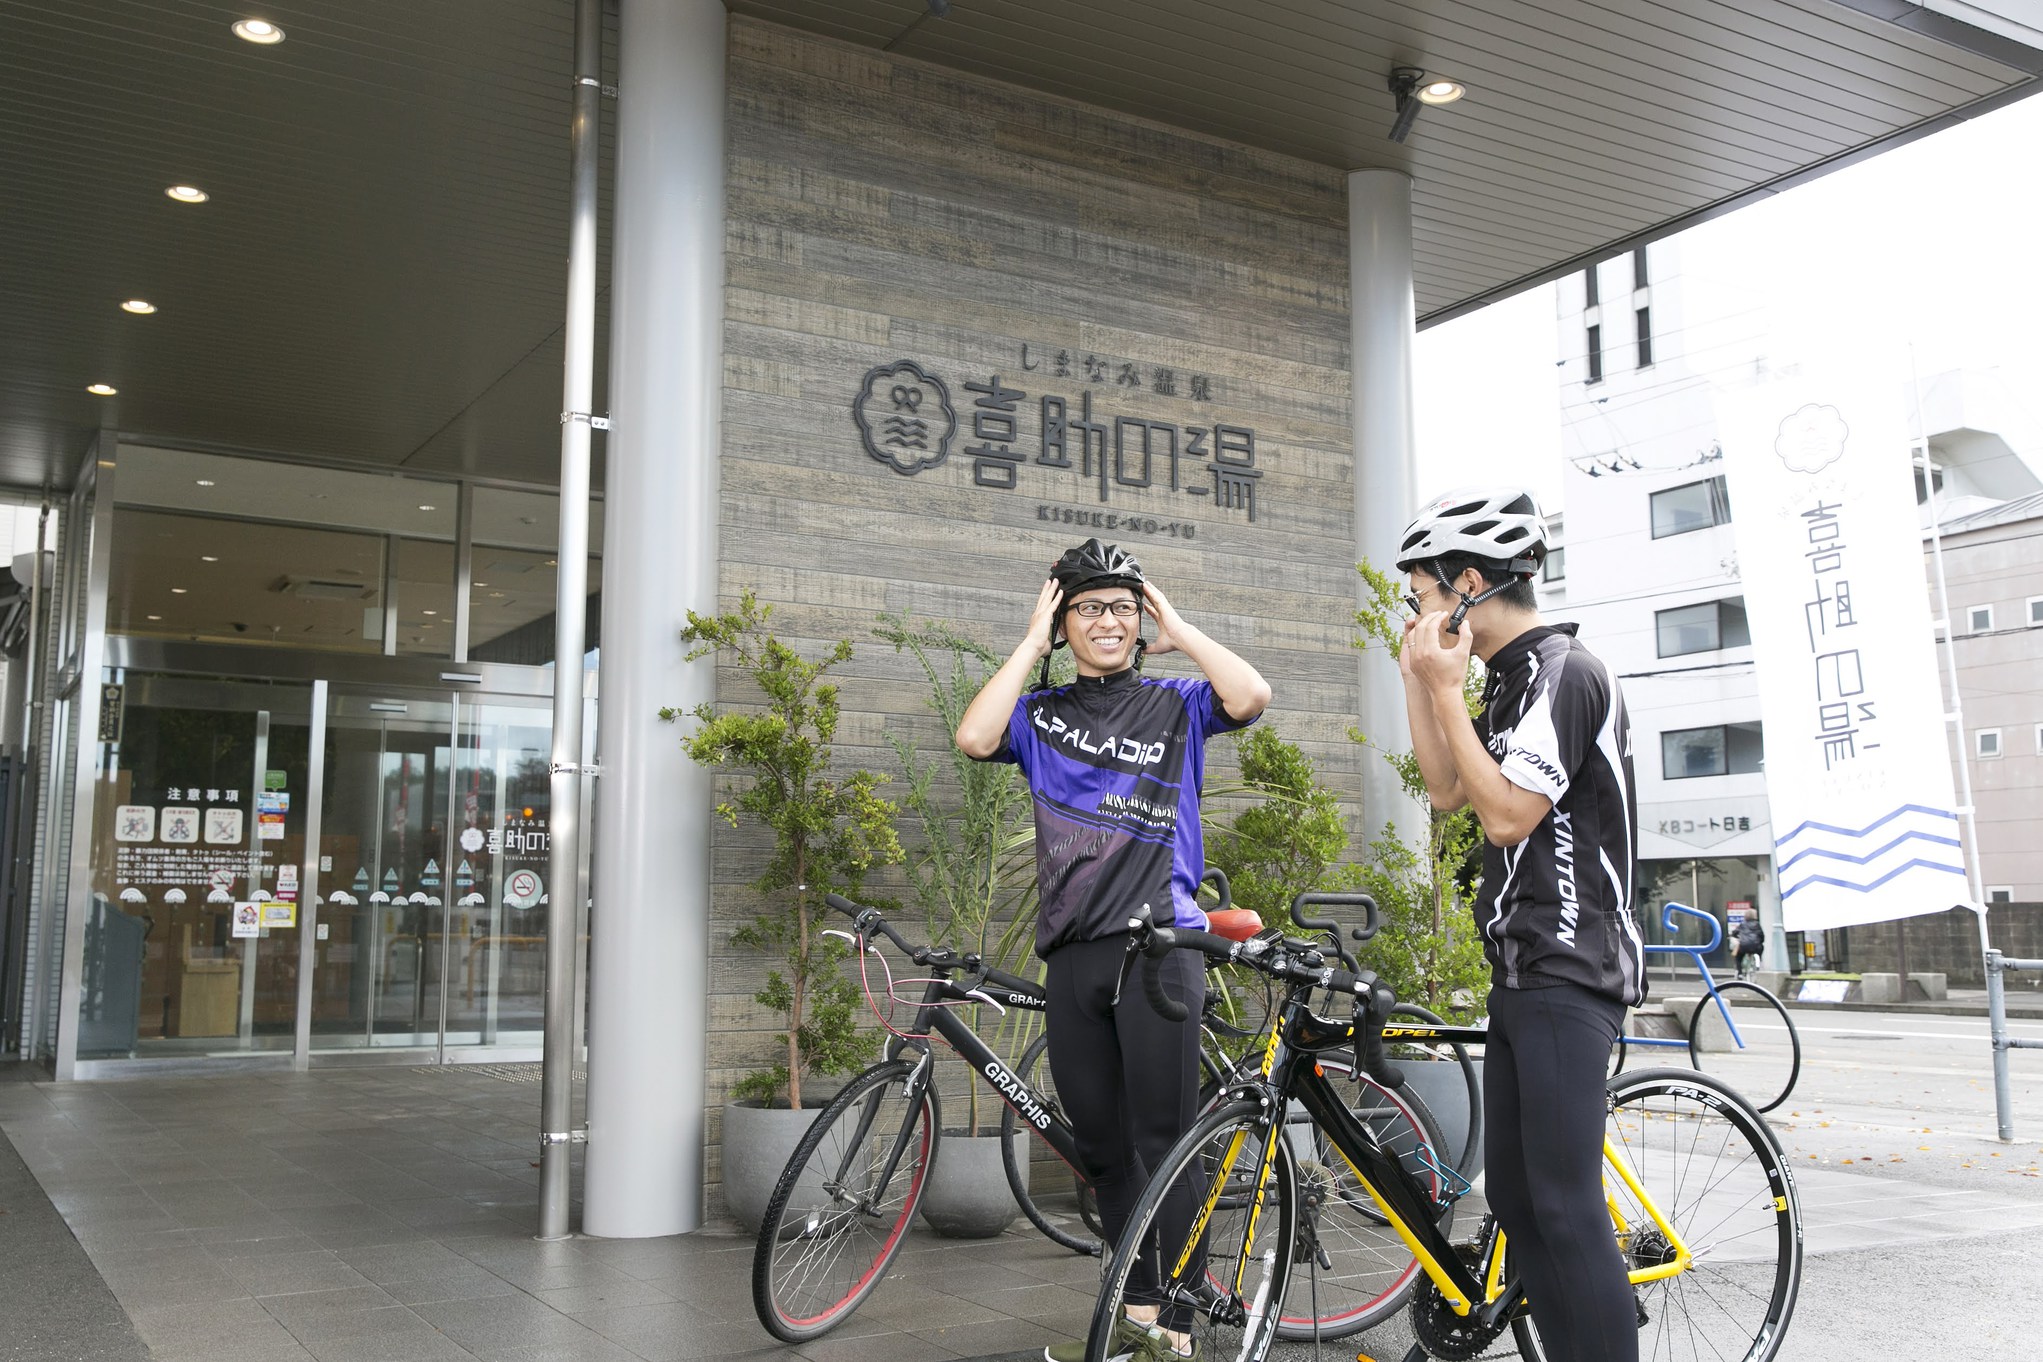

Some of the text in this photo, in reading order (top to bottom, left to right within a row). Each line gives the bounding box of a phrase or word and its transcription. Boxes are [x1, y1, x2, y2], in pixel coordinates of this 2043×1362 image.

[1022, 342, 1212, 400] しまなみ温泉
[964, 375, 1264, 523] 喜助の湯
[1037, 504, 1196, 540] KISUKE-NO-YU
[167, 787, 239, 802] 注意事項
[1553, 805, 1580, 949] XINTOWN
[984, 1062, 1051, 1129] GRAPHIS
[1665, 1086, 1722, 1108] PA-2
